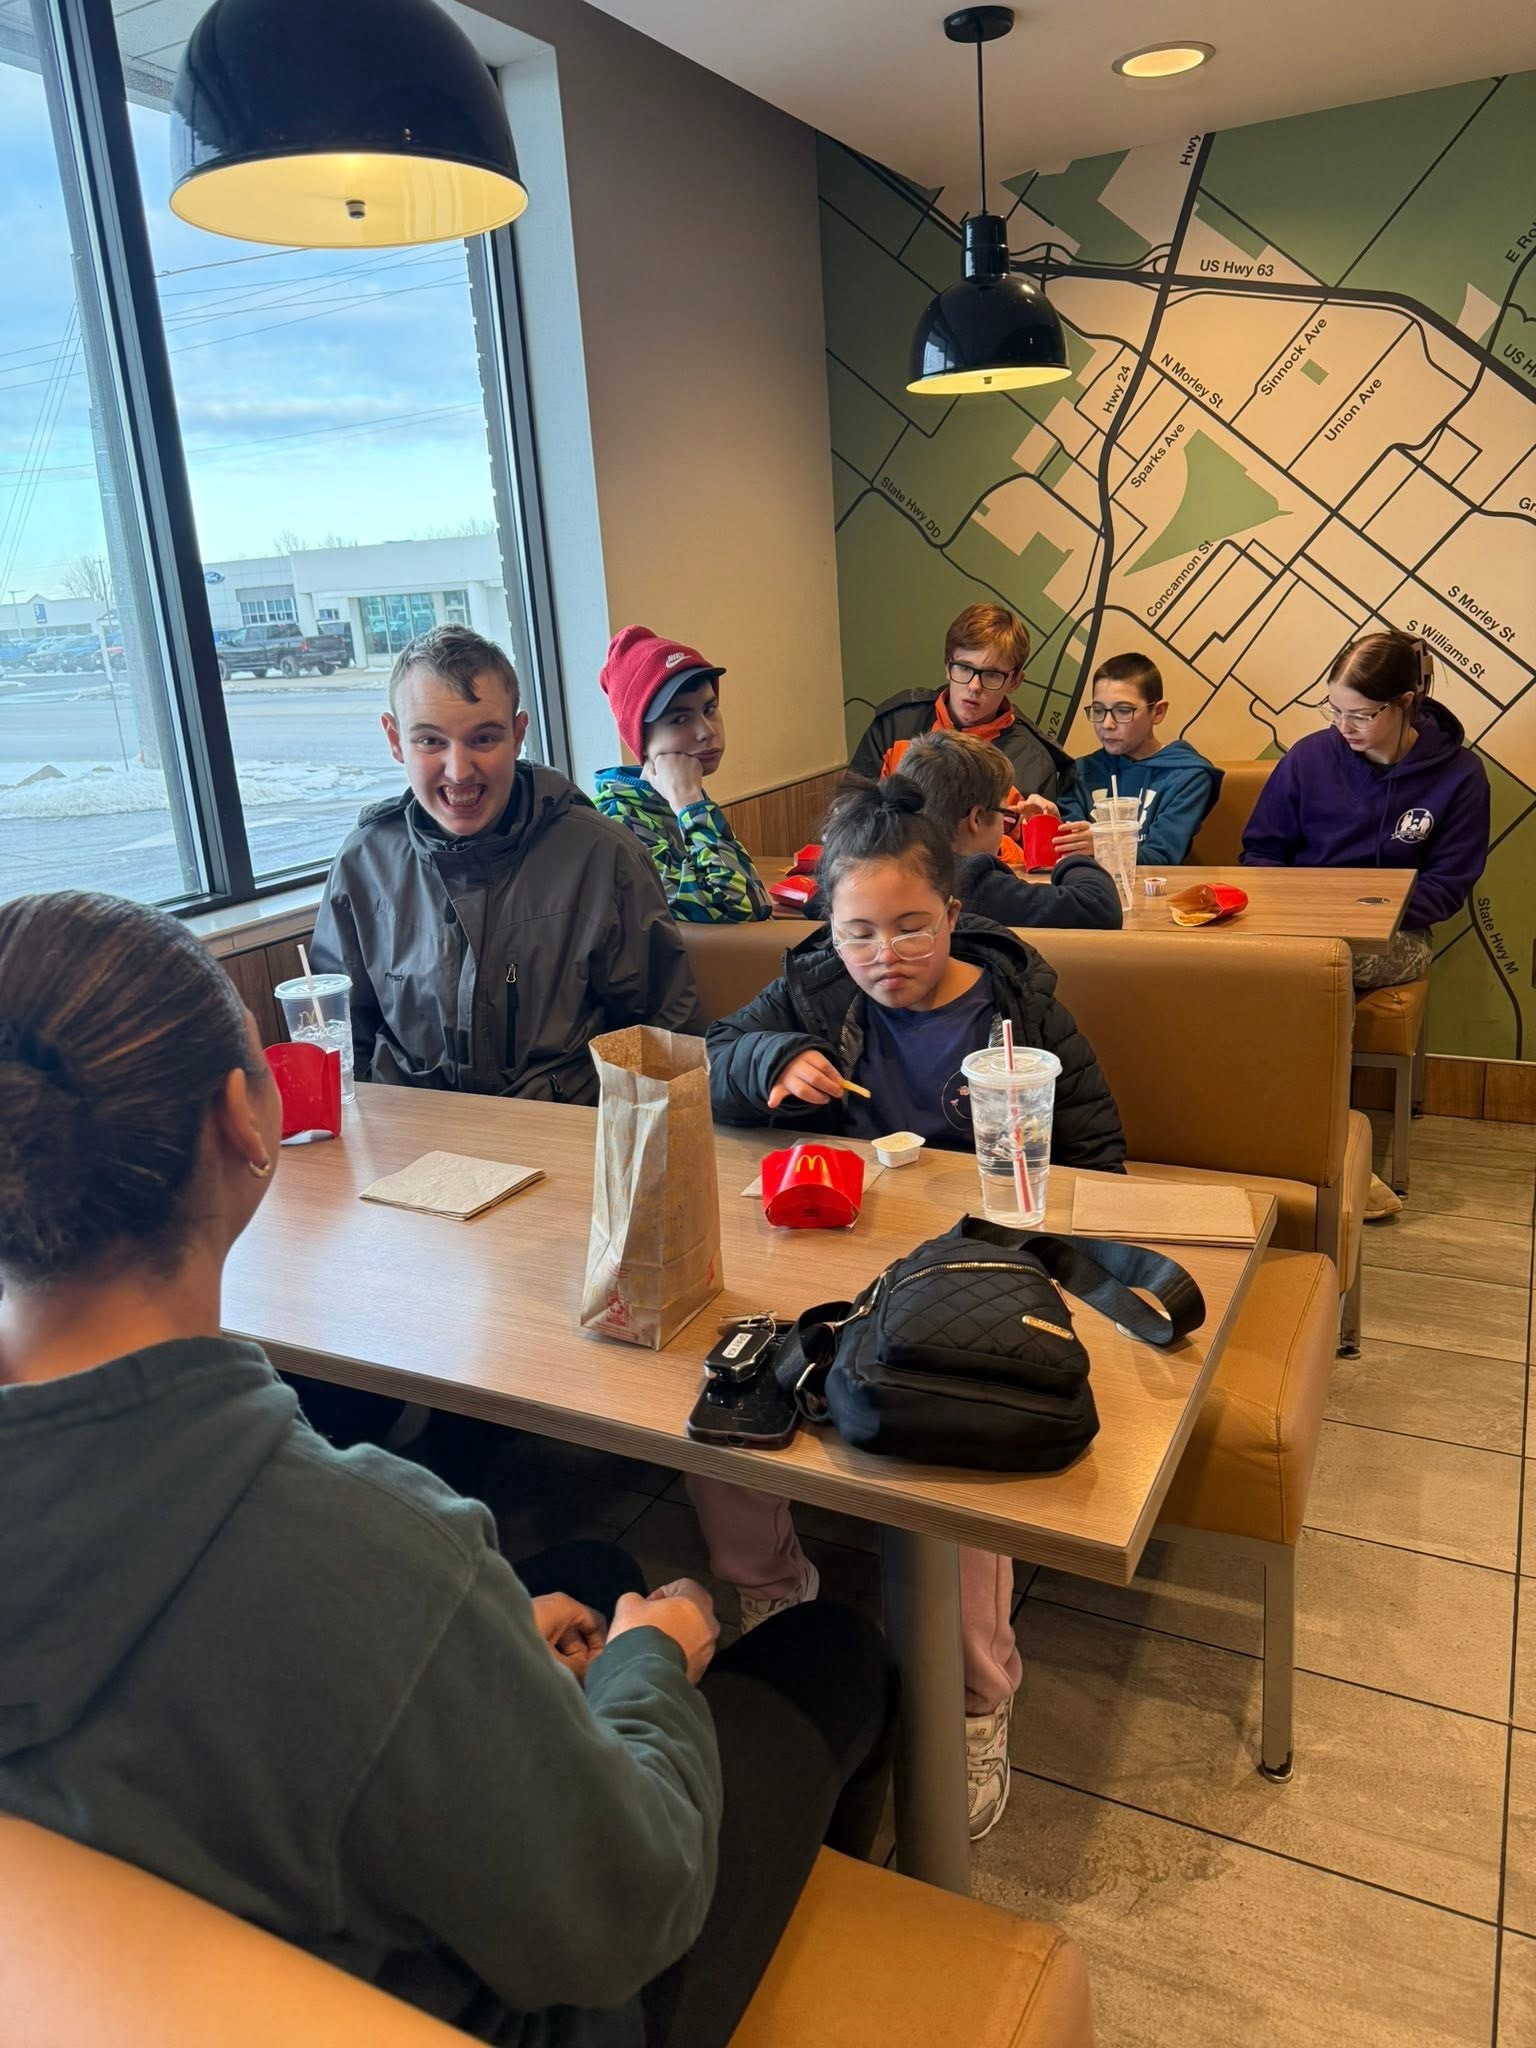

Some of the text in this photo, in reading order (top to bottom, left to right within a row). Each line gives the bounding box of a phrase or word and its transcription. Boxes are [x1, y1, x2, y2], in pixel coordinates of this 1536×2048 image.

[1180, 135, 1201, 166] Hwy
[1200, 259, 1274, 277] US Hwy 63
[1505, 222, 1536, 263] E Ro
[1161, 354, 1224, 409] N Morley St
[1261, 319, 1327, 396] Sinnock Ave
[1503, 344, 1536, 378] US H
[1103, 365, 1131, 415] Hwy 24
[1324, 379, 1382, 441] Union Ave
[1131, 423, 1185, 488] Sparks Ave
[881, 476, 941, 538] State Hwy DD
[1519, 497, 1536, 513] Gr
[1146, 539, 1214, 618] Concannon St
[1448, 586, 1516, 643] S Morley St
[1406, 620, 1486, 679] S Williams St
[1050, 711, 1062, 726] 24
[1478, 897, 1520, 975] State Hwy M
